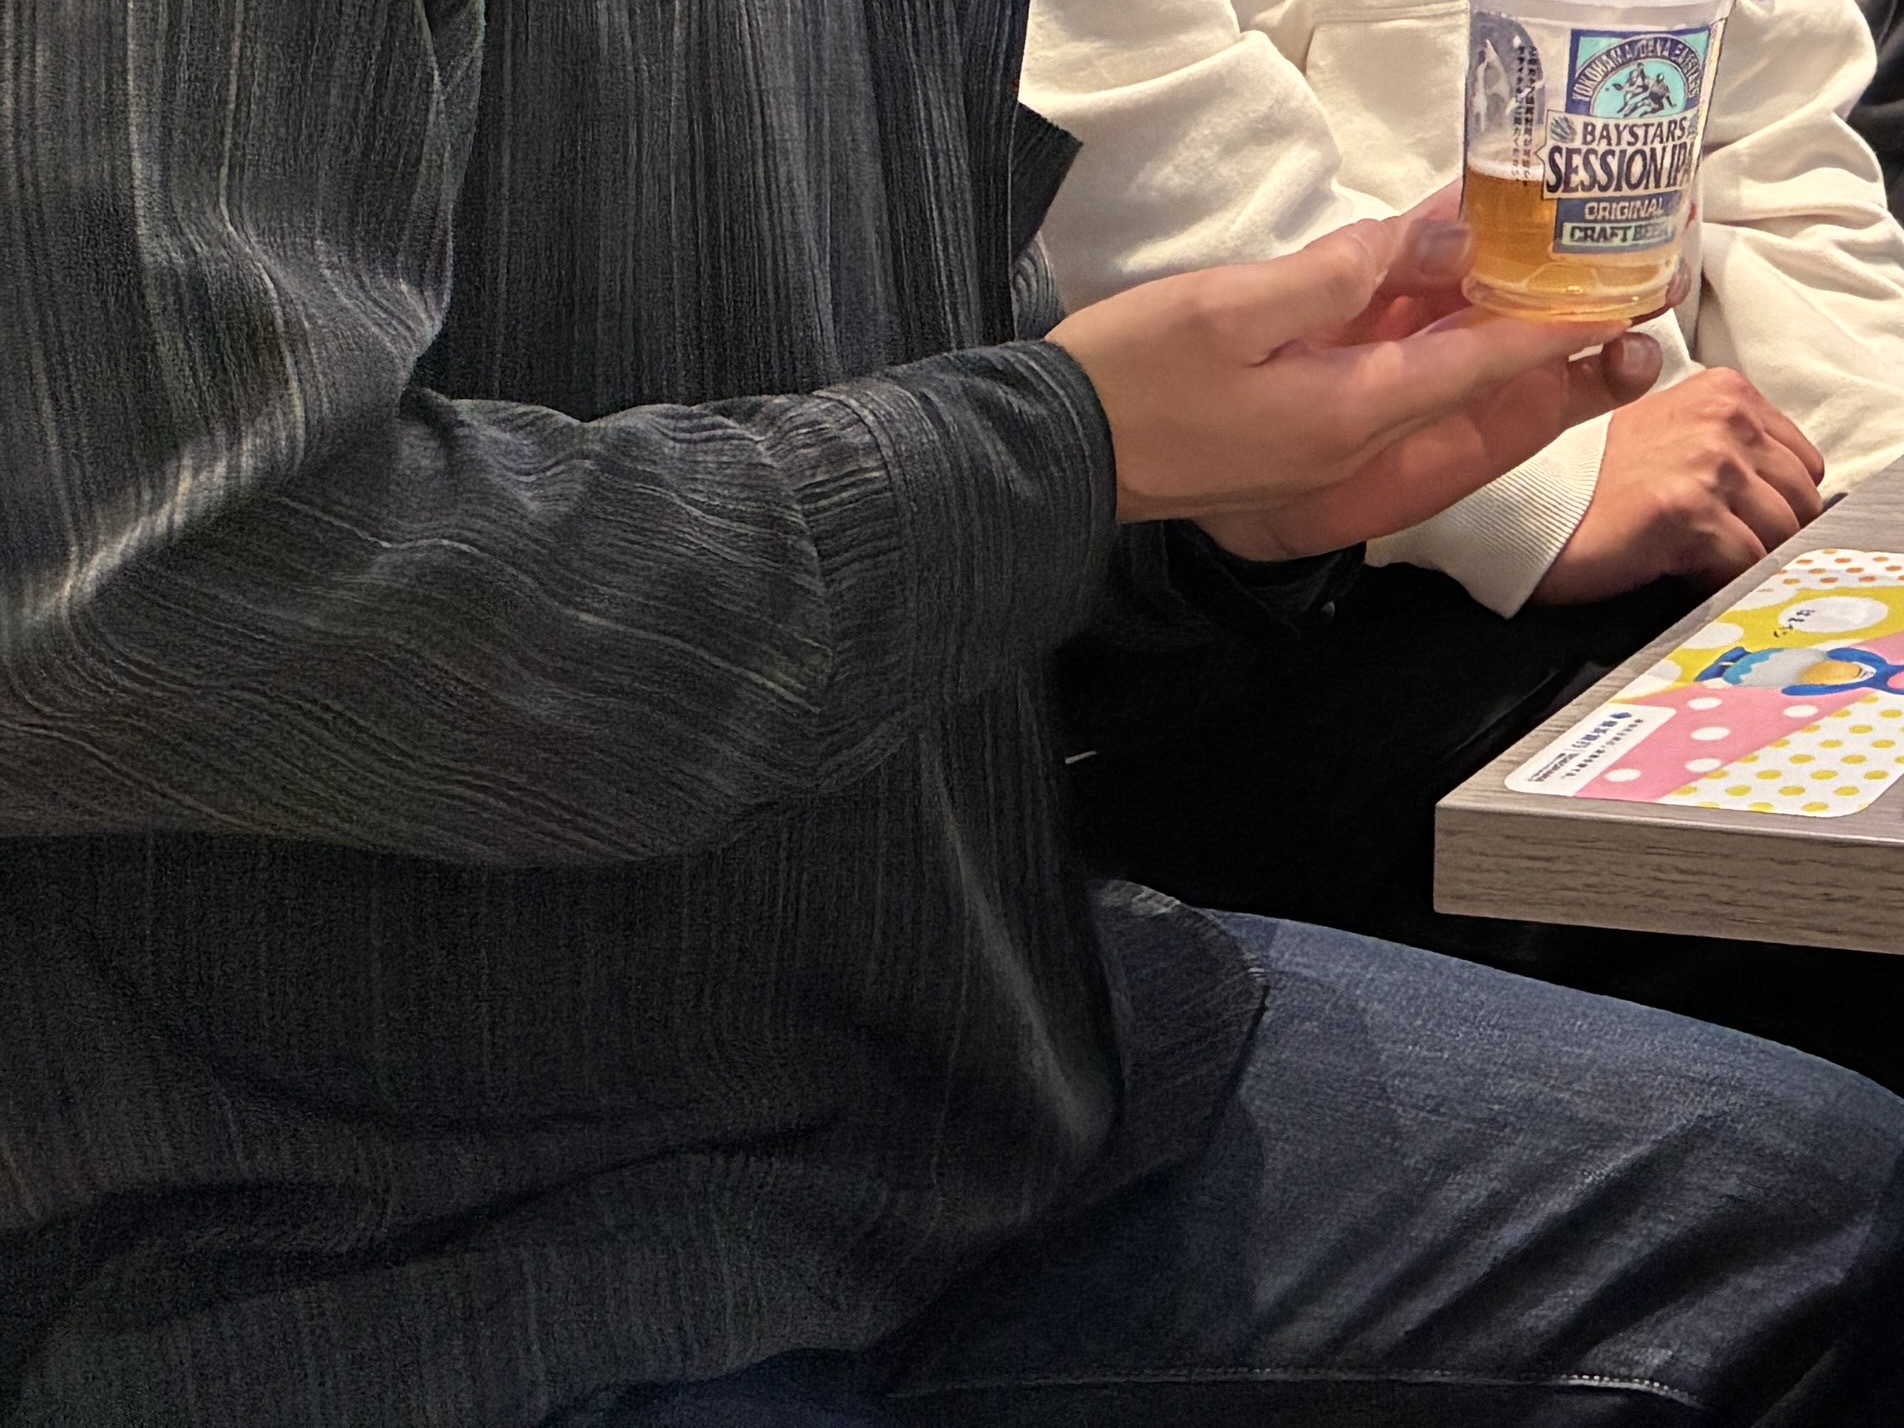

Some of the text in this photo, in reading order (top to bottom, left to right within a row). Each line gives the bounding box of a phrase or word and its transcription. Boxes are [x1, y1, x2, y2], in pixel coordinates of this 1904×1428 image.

[1582, 116, 1688, 147] BAYSTARS
[1546, 145, 1668, 194] SESSION
[1584, 197, 1664, 221] ORIGINAL
[1569, 224, 1632, 243] CRAFT
